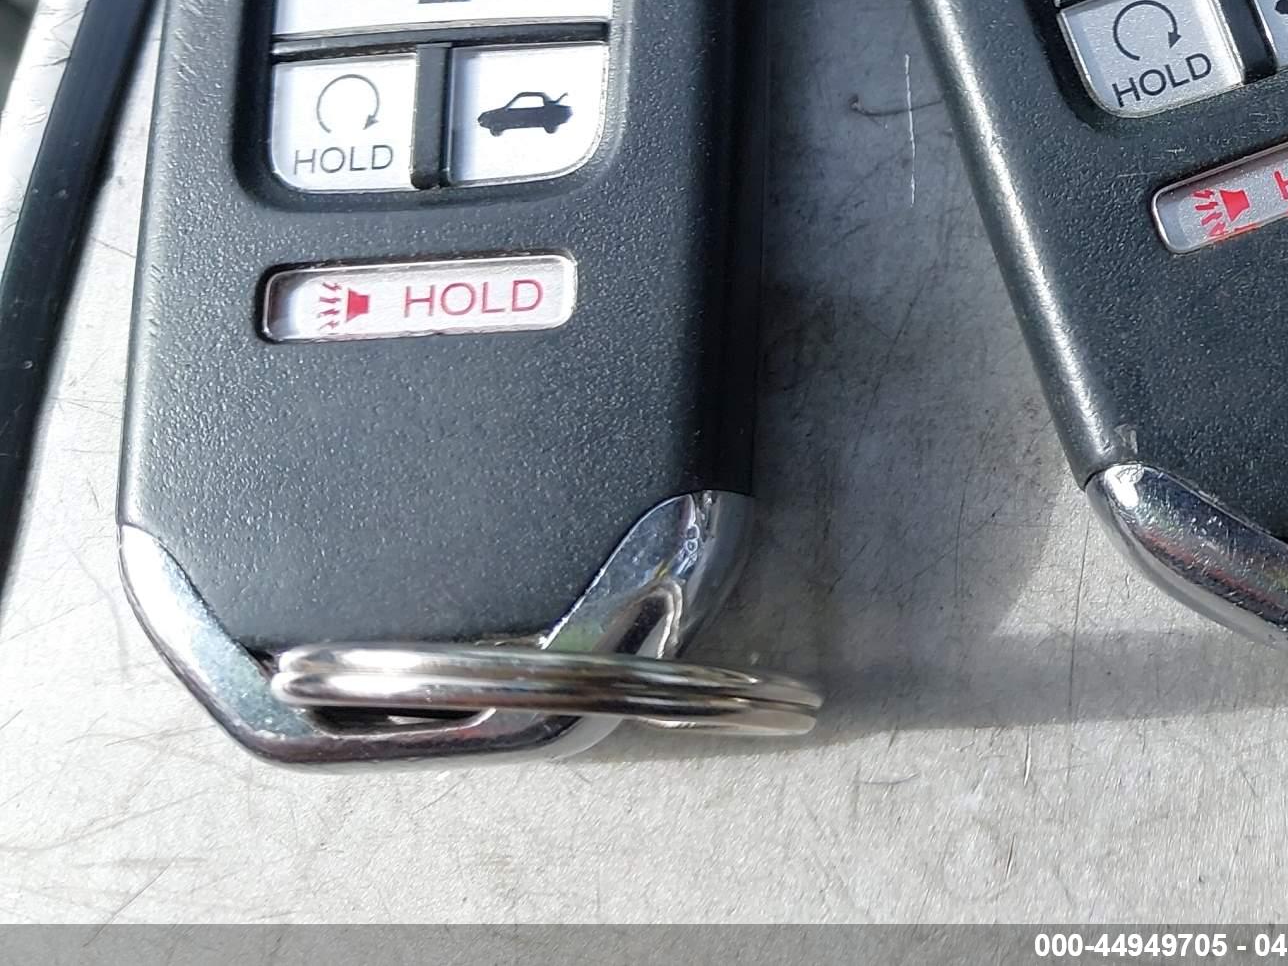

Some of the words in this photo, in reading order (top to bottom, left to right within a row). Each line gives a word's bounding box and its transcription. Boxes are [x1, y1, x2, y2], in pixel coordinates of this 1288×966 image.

[1112, 52, 1212, 108] HOLD
[293, 144, 395, 175] HOLD
[403, 278, 545, 318] HOLD
